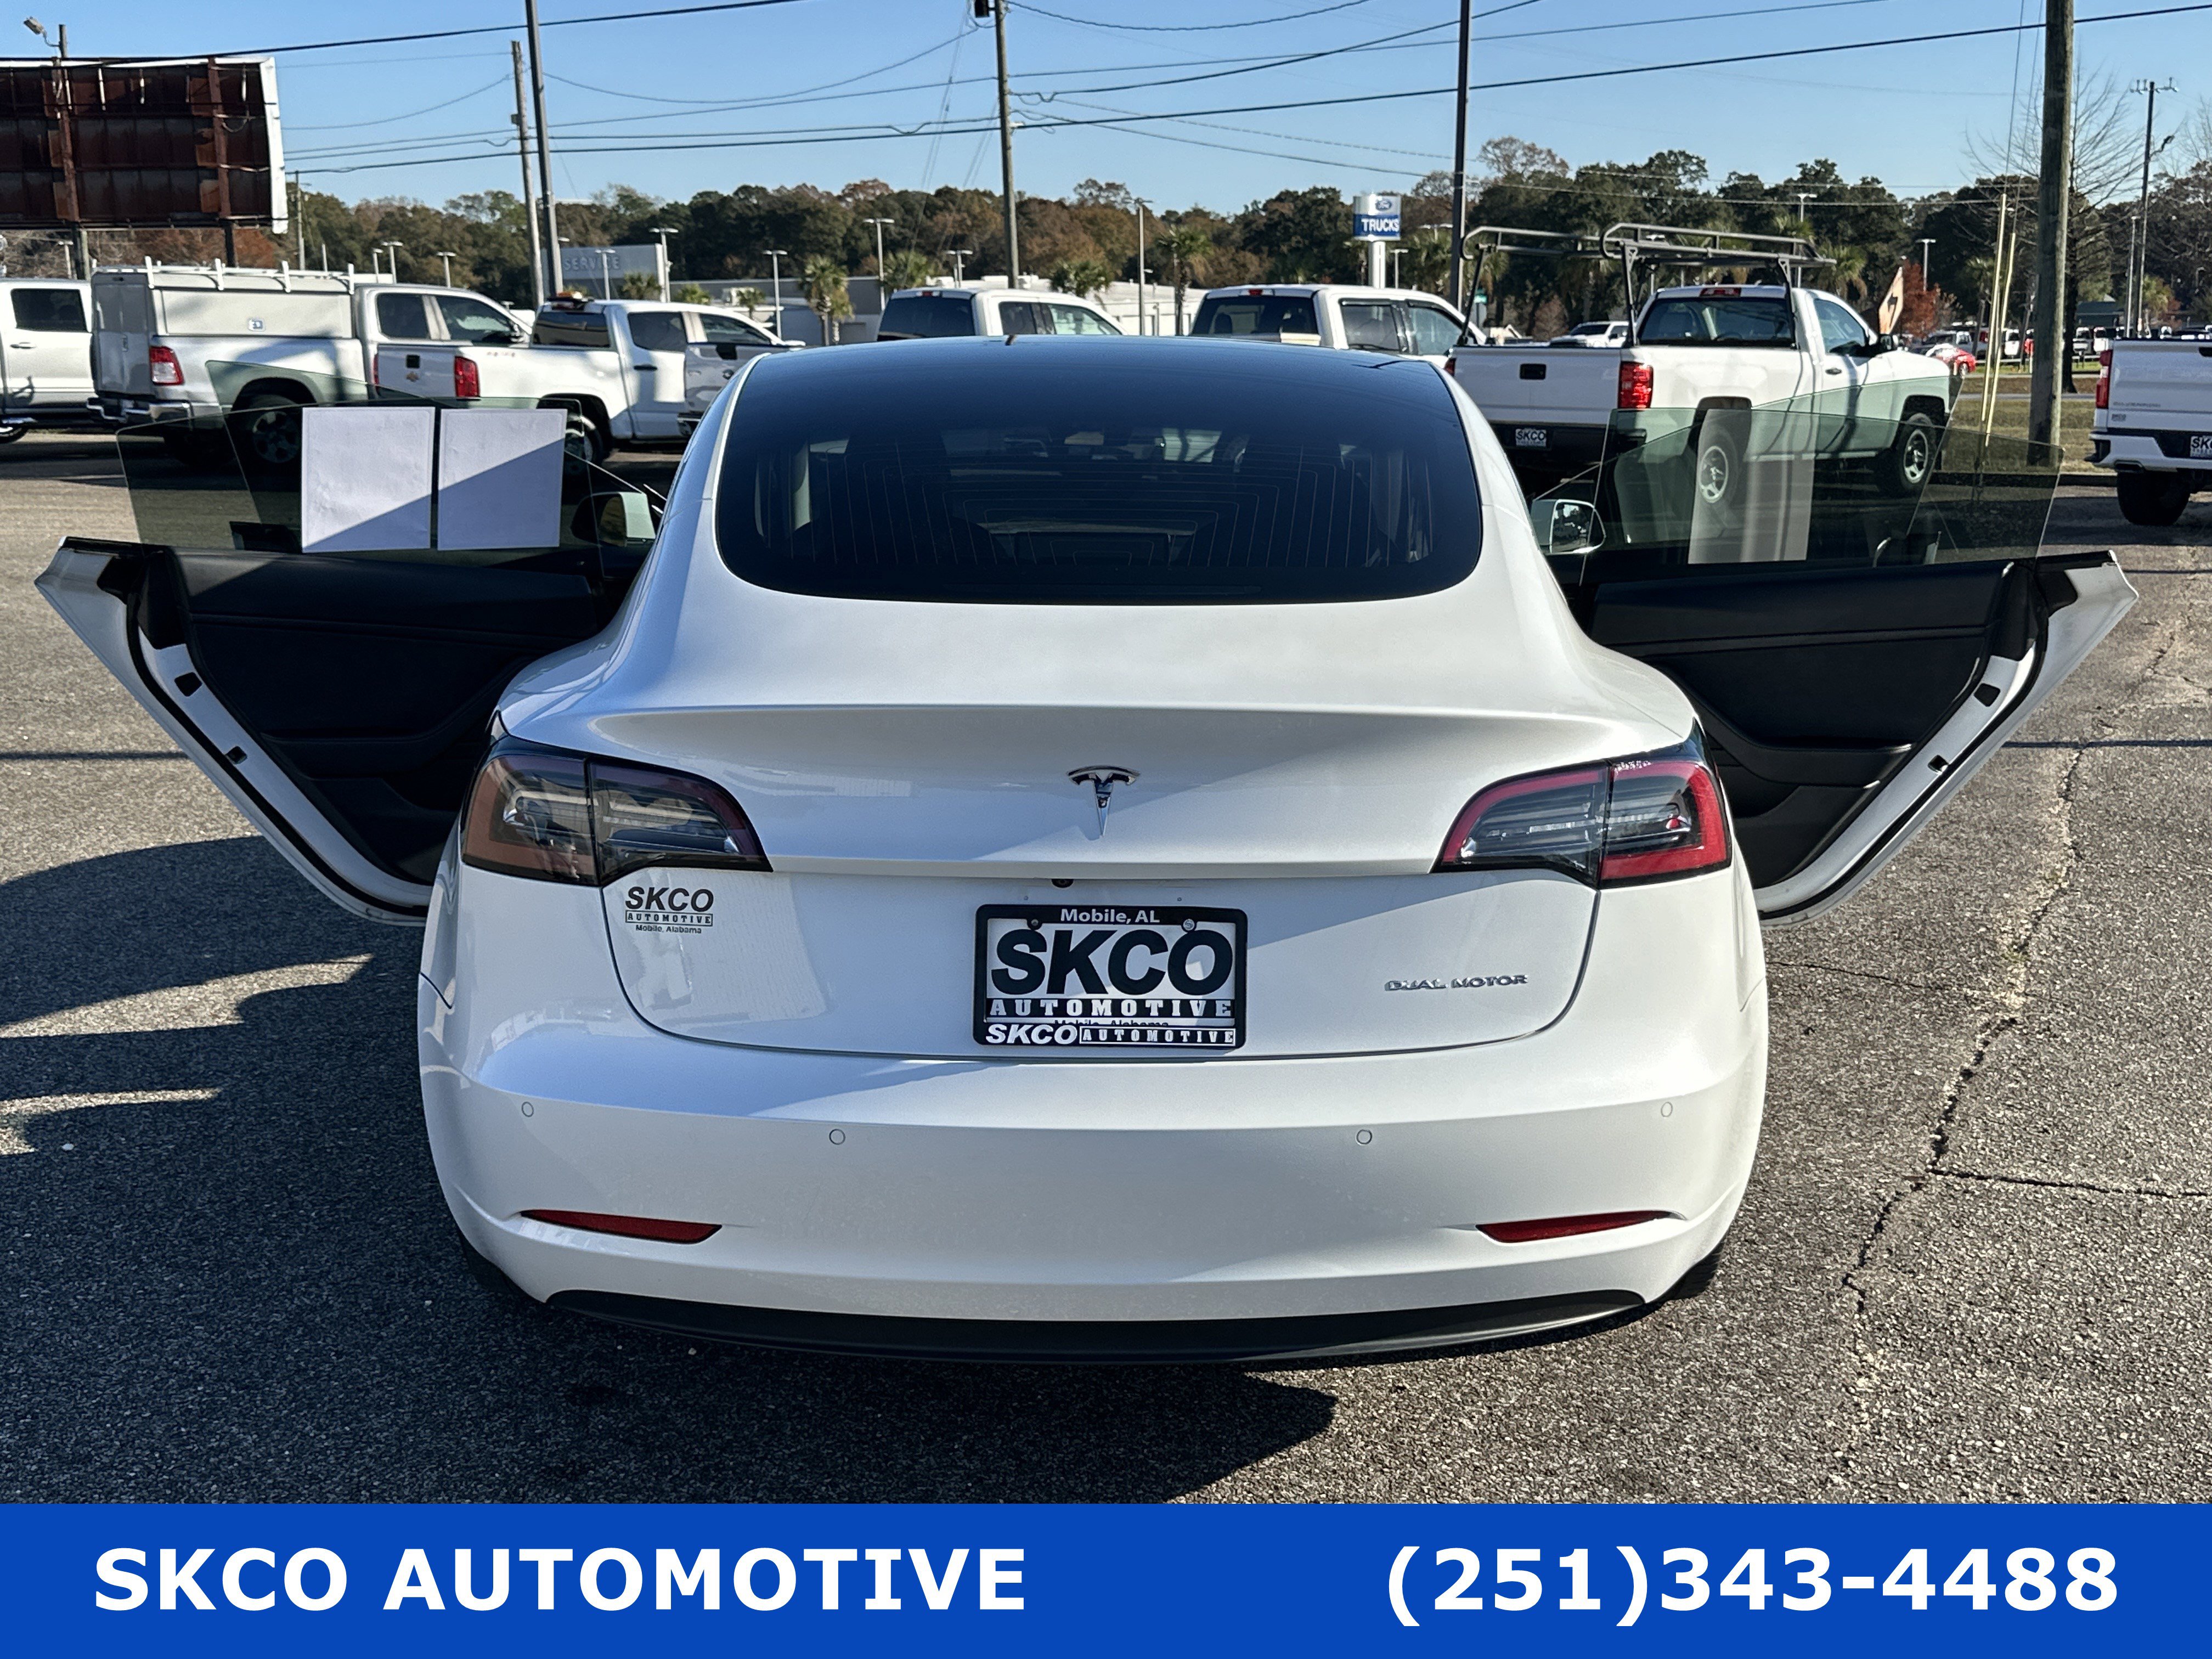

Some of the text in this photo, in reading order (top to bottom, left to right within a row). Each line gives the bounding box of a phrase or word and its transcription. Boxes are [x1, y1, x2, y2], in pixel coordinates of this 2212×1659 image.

[1361, 218, 1400, 232] TRUCKS
[1516, 430, 1545, 441] SKCO
[2192, 437, 2212, 449] SK
[625, 886, 714, 912] SKCO
[628, 912, 711, 924] AUTOMOTIVE
[1060, 909, 1160, 924] Mobile, AL
[991, 929, 1233, 996] SKCO
[1385, 974, 1528, 991] DUAL MOTOR
[990, 999, 1232, 1017] AUTOMOTIVE
[986, 1024, 1233, 1044] SKCO AUTOMOTIVE
